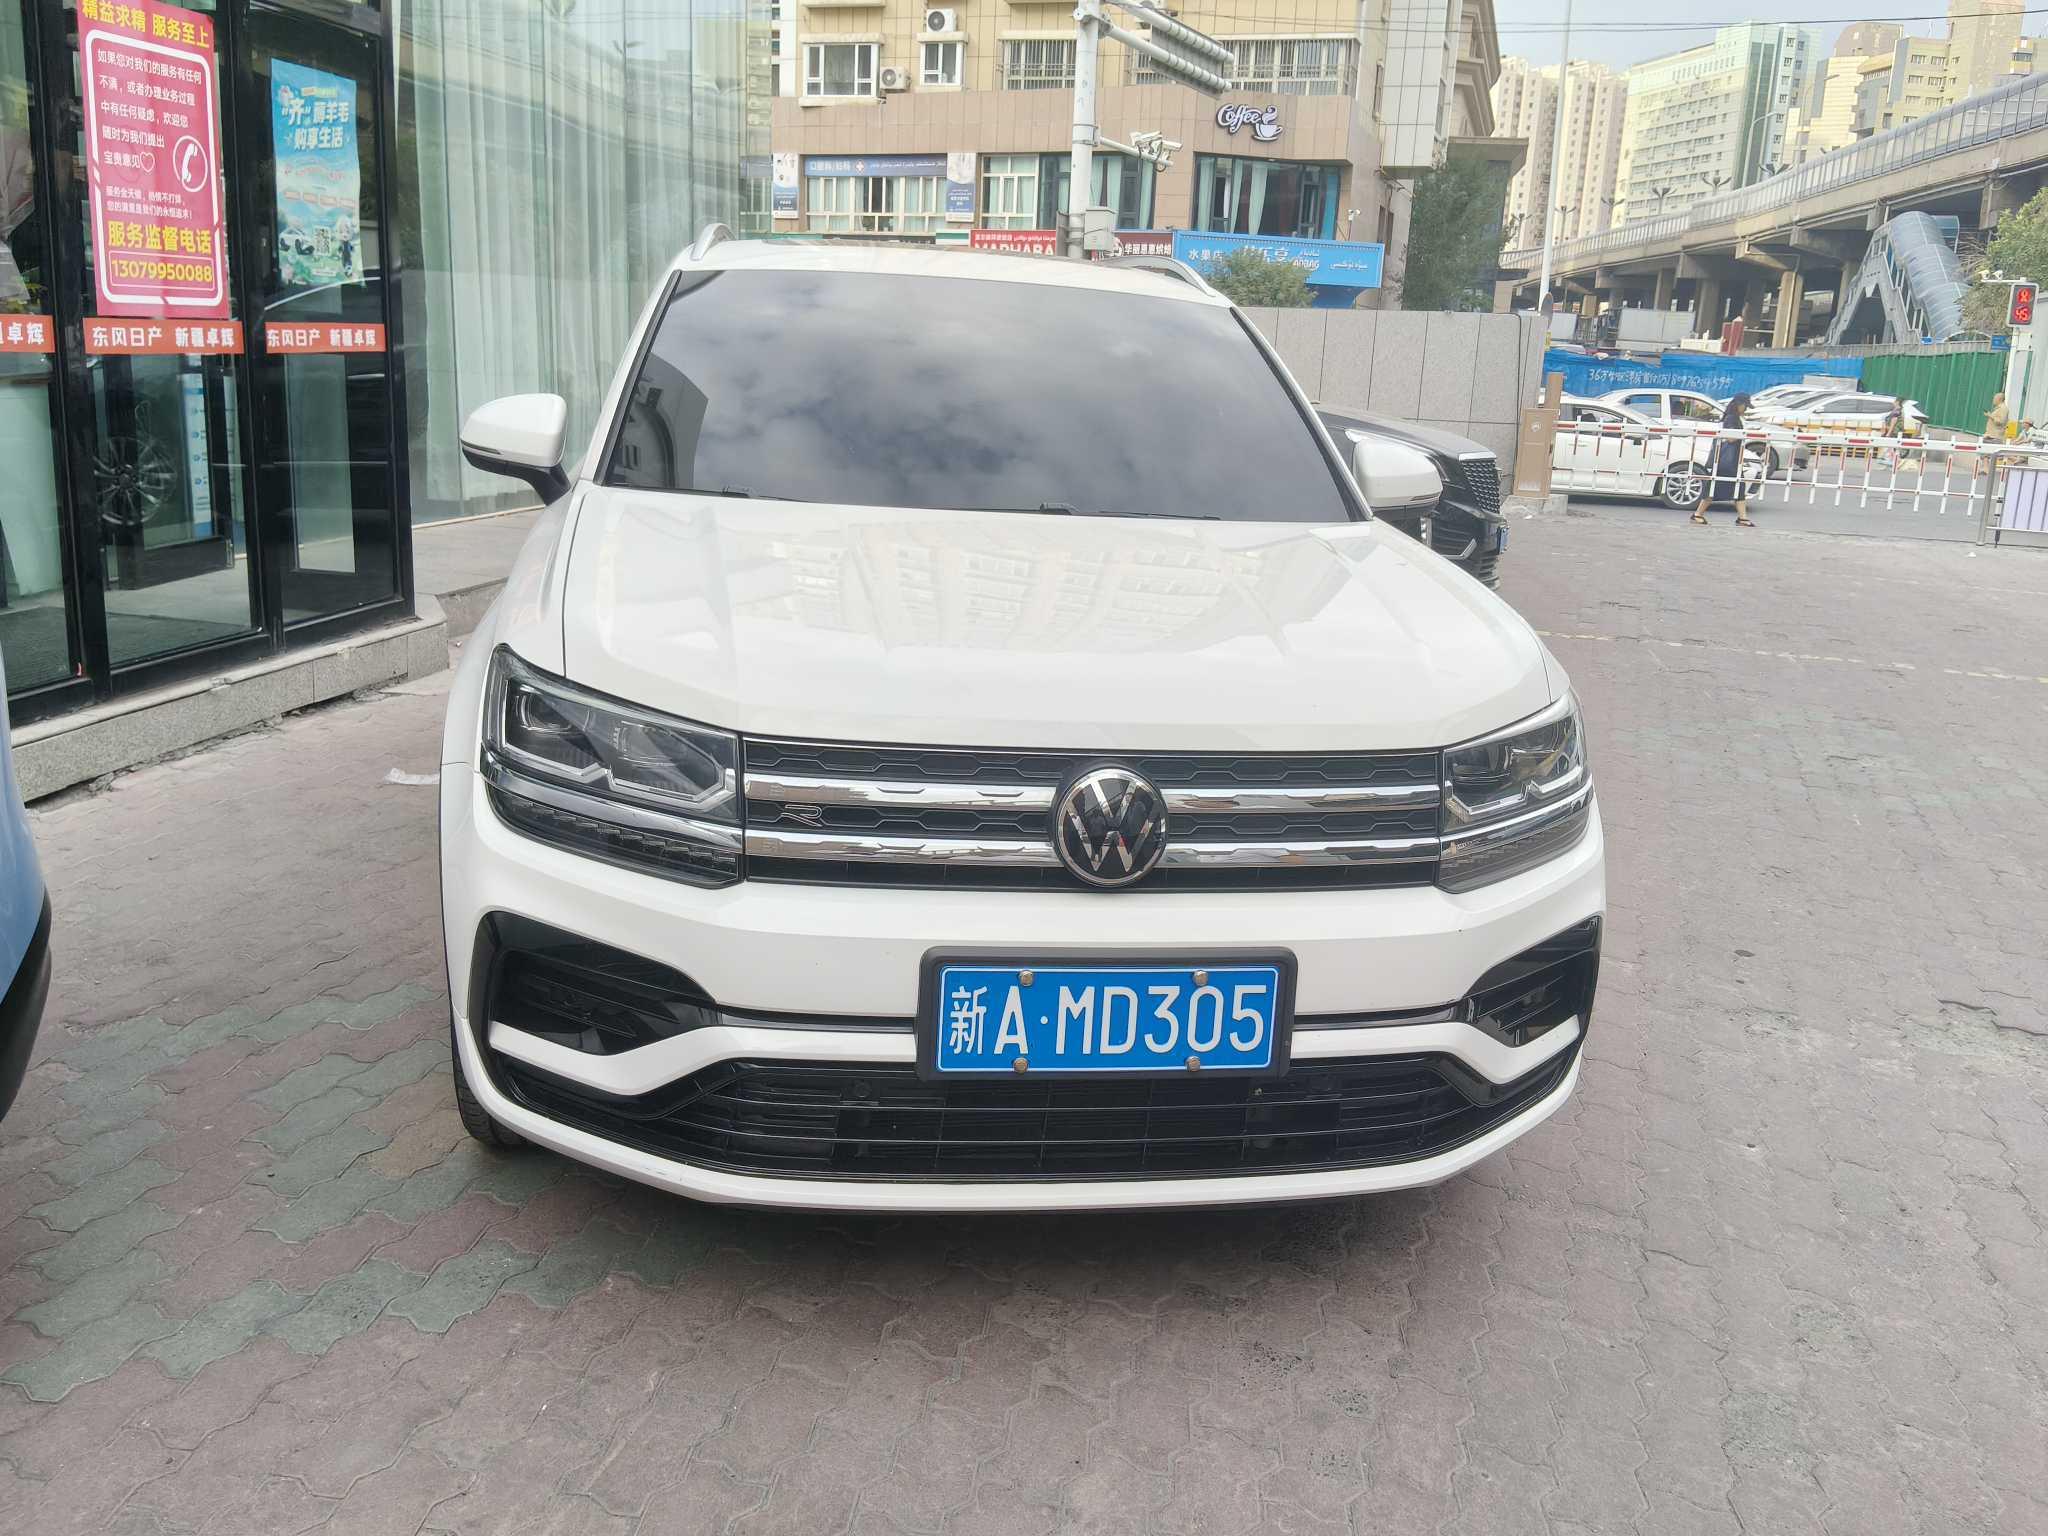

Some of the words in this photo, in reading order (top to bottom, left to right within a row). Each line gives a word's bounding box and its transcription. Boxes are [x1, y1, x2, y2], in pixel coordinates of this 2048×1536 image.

[82, 0, 146, 33] 精益求精
[152, 14, 210, 48] 服务至上
[1217, 103, 1262, 134] Coffee
[108, 221, 212, 255] 服务监督电话
[112, 259, 213, 283] 13079950088
[2015, 307, 2029, 321] 45
[0, 321, 45, 345] 卓辉
[92, 326, 163, 347] 东风日产
[175, 327, 235, 348] 新疆卓辉
[266, 327, 322, 347] 东风日产
[329, 328, 377, 347] 新疆卓辉
[948, 984, 1268, 1055] 新A·MD305
